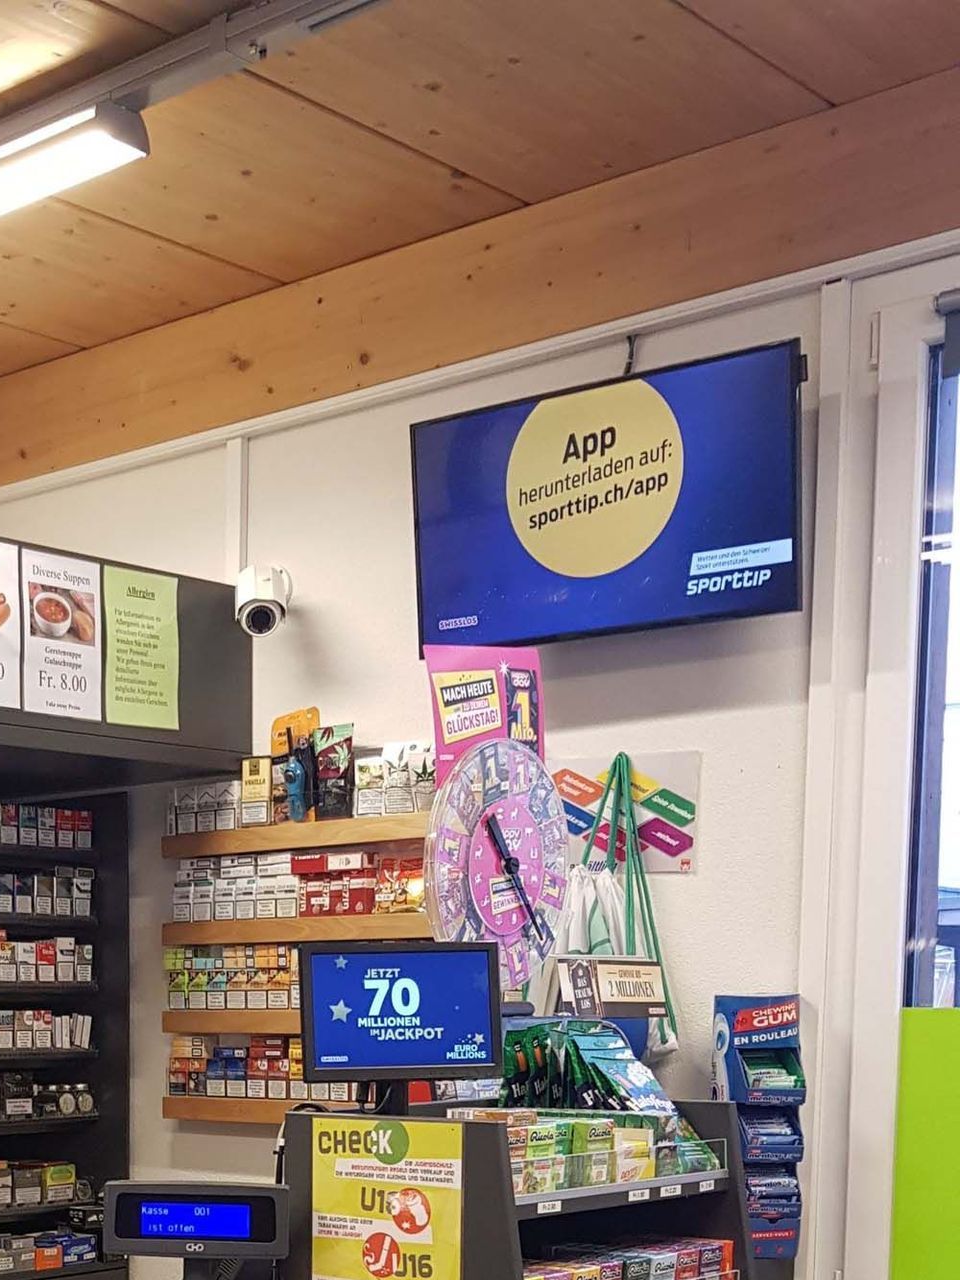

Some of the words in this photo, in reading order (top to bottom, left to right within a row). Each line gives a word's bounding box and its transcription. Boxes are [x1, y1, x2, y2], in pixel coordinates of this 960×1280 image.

[563, 425, 616, 464] App
[519, 453, 634, 507] herunterladen
[639, 439, 673, 466] auf:
[529, 472, 669, 530] sporttip.ch/app
[32, 565, 61, 580] Diverse
[63, 568, 90, 586] Suppen
[126, 586, 155, 599] Allergien
[439, 615, 478, 630] SWISSLOS
[45, 646, 82, 660] Gerstensuppe
[39, 670, 56, 689] Fr.
[60, 674, 87, 693] 8.00
[443, 685, 467, 702] MACH
[467, 680, 493, 696] HEUTE
[446, 709, 499, 734] GLÜCKSTAG!
[511, 723, 537, 741] Mio.
[365, 968, 400, 978] JETZT
[608, 982, 615, 997] 2
[616, 981, 656, 998] MILLIONEN
[364, 978, 420, 1016] 70
[752, 1002, 796, 1018] CHEWING
[358, 1017, 420, 1027] MILLIONEN
[752, 1011, 797, 1028] GUM
[371, 1029, 379, 1037] IM
[378, 1027, 444, 1041] JACKPOT
[734, 1036, 749, 1046] EN
[752, 1027, 798, 1043] ROULEAU
[446, 1051, 487, 1059] MILLIONS
[454, 1044, 478, 1052] EURO
[529, 1131, 554, 1143] Ricola
[589, 1127, 612, 1138] Ricola
[141, 1207, 169, 1215] Kasse
[194, 1208, 210, 1216] 001
[148, 1224, 163, 1232] ist
[168, 1224, 195, 1233] offen
[678, 1254, 698, 1266] Ricola
[702, 1249, 722, 1262] Ricola
[600, 1267, 622, 1279] Ricola
[628, 1263, 650, 1275] Ricola
[655, 1260, 675, 1273] Ricola
